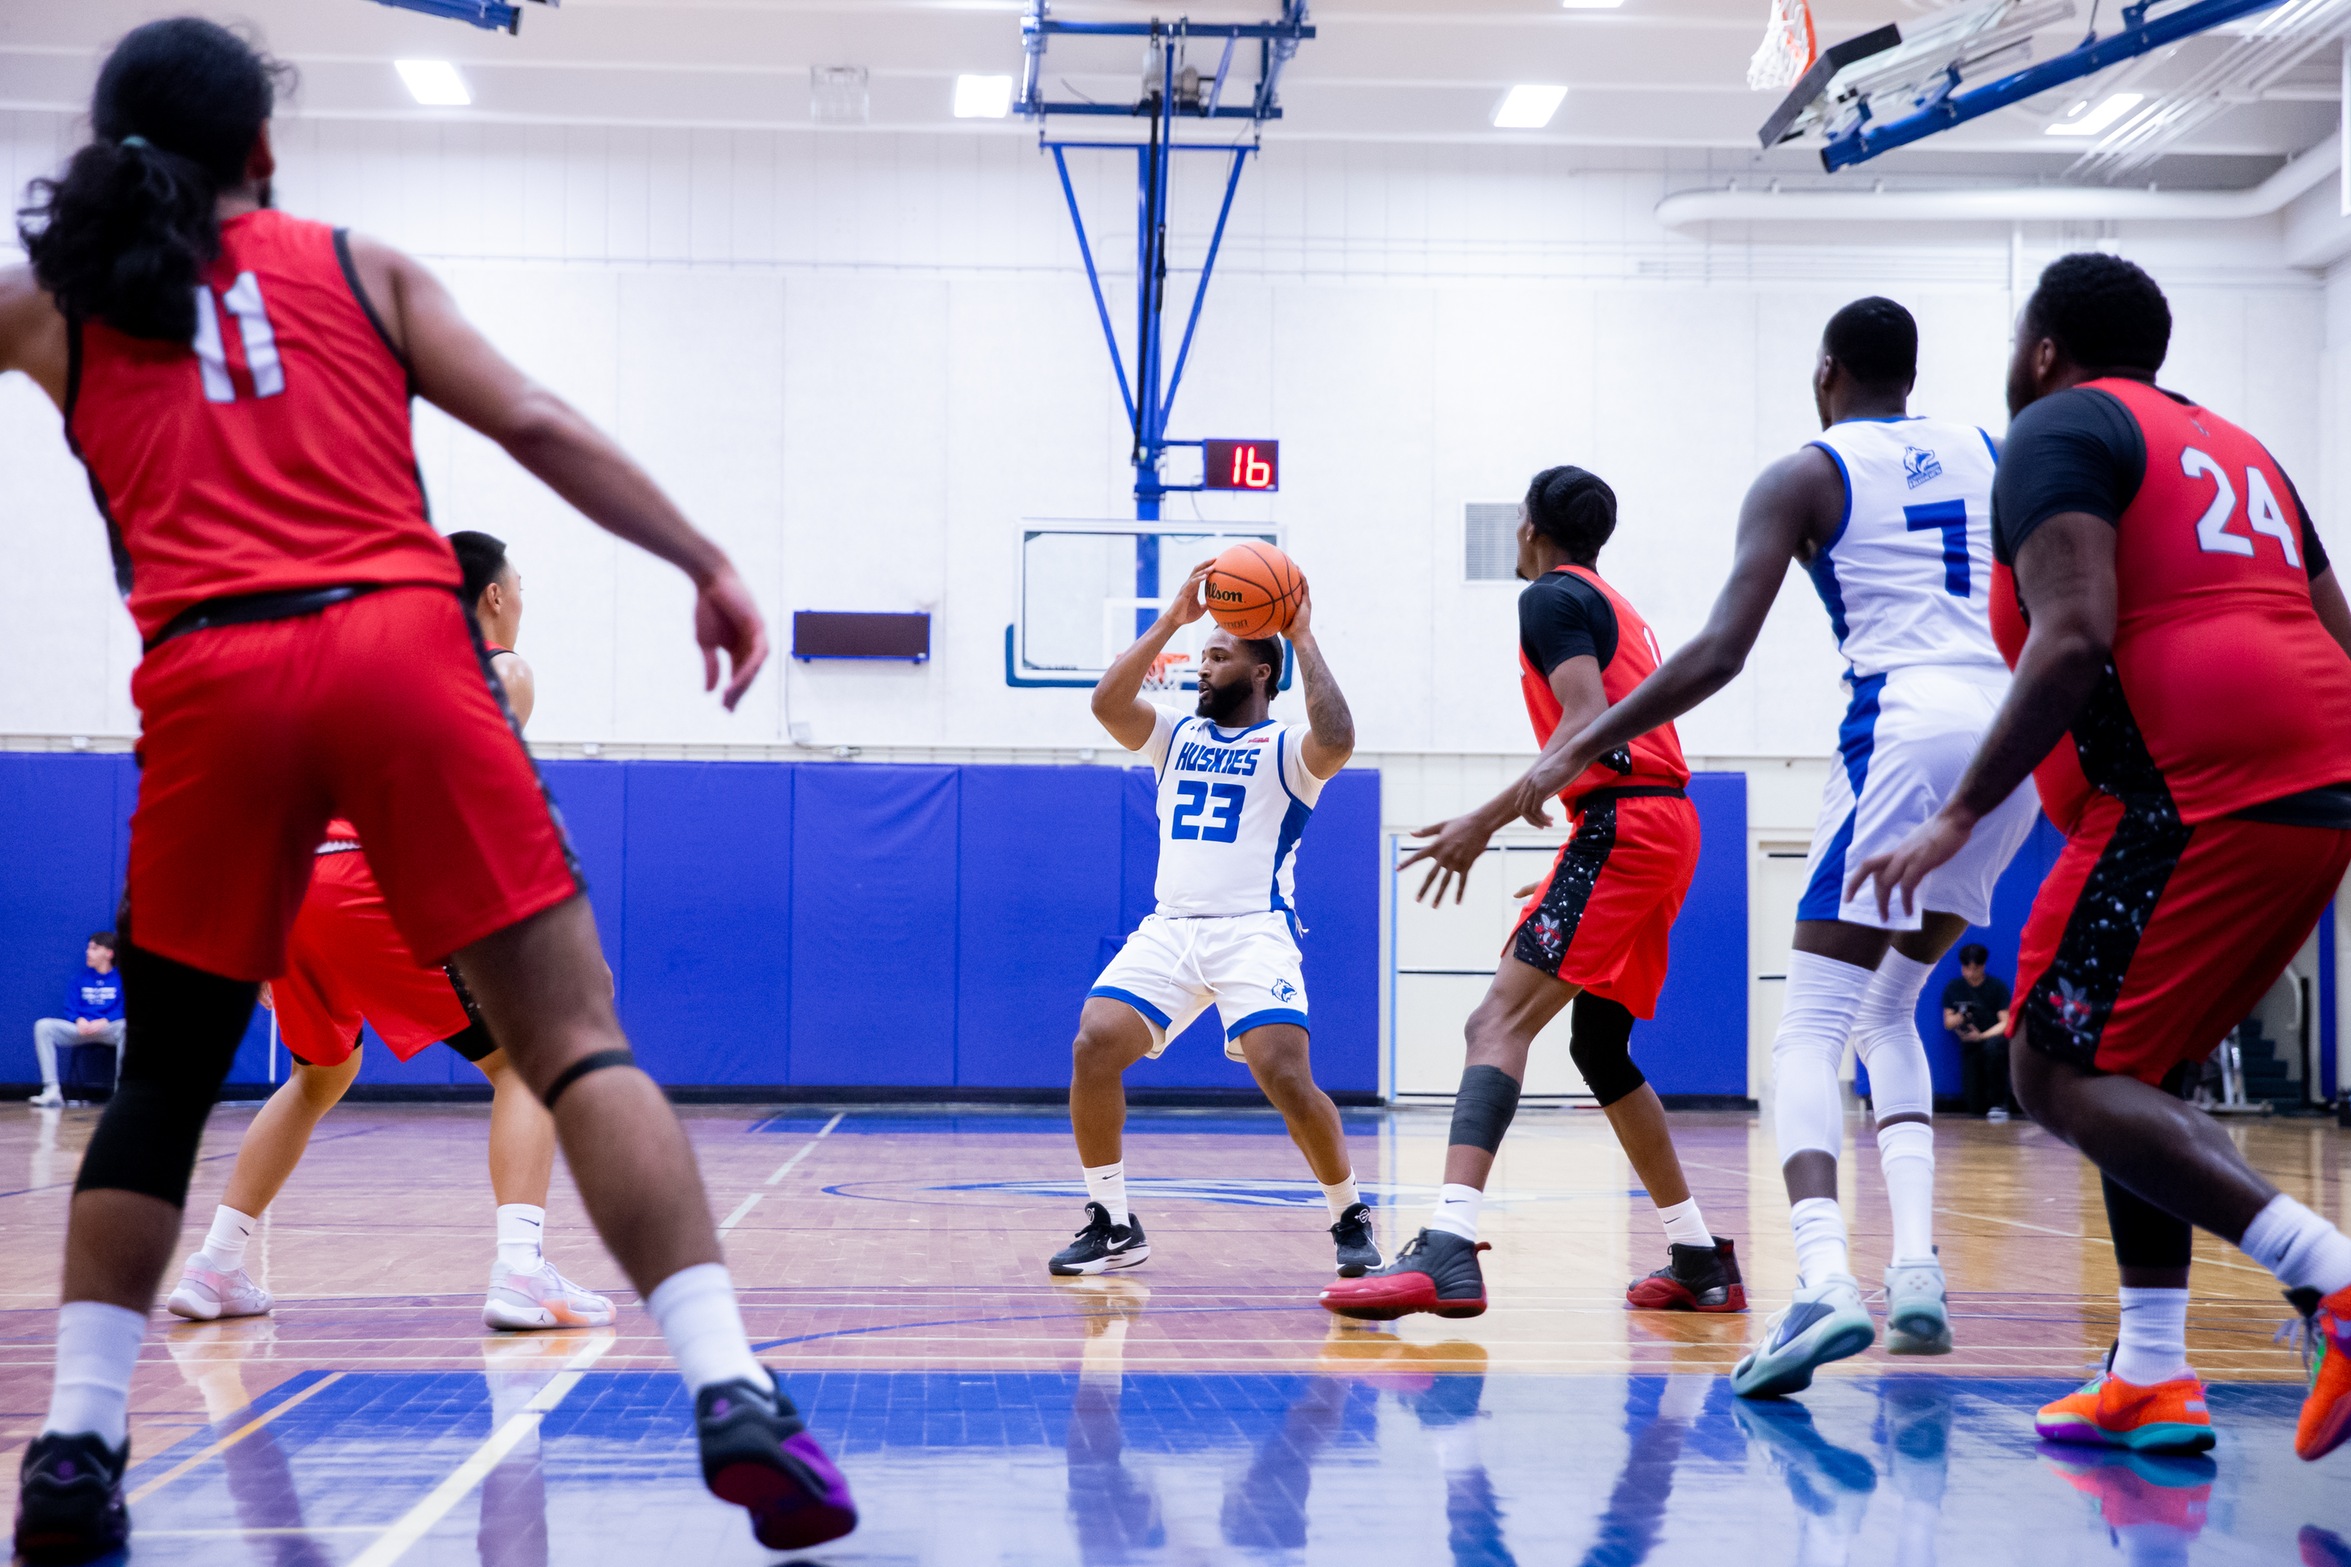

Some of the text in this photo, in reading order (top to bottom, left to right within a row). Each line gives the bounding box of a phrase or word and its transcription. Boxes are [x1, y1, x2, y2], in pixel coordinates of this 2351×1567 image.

[193, 270, 285, 403] 11
[1233, 446, 1270, 487] 16
[2179, 445, 2301, 569] 24
[1903, 498, 1970, 598] 7
[1174, 741, 1261, 777] HUSKIES
[1171, 780, 1246, 843] 23
